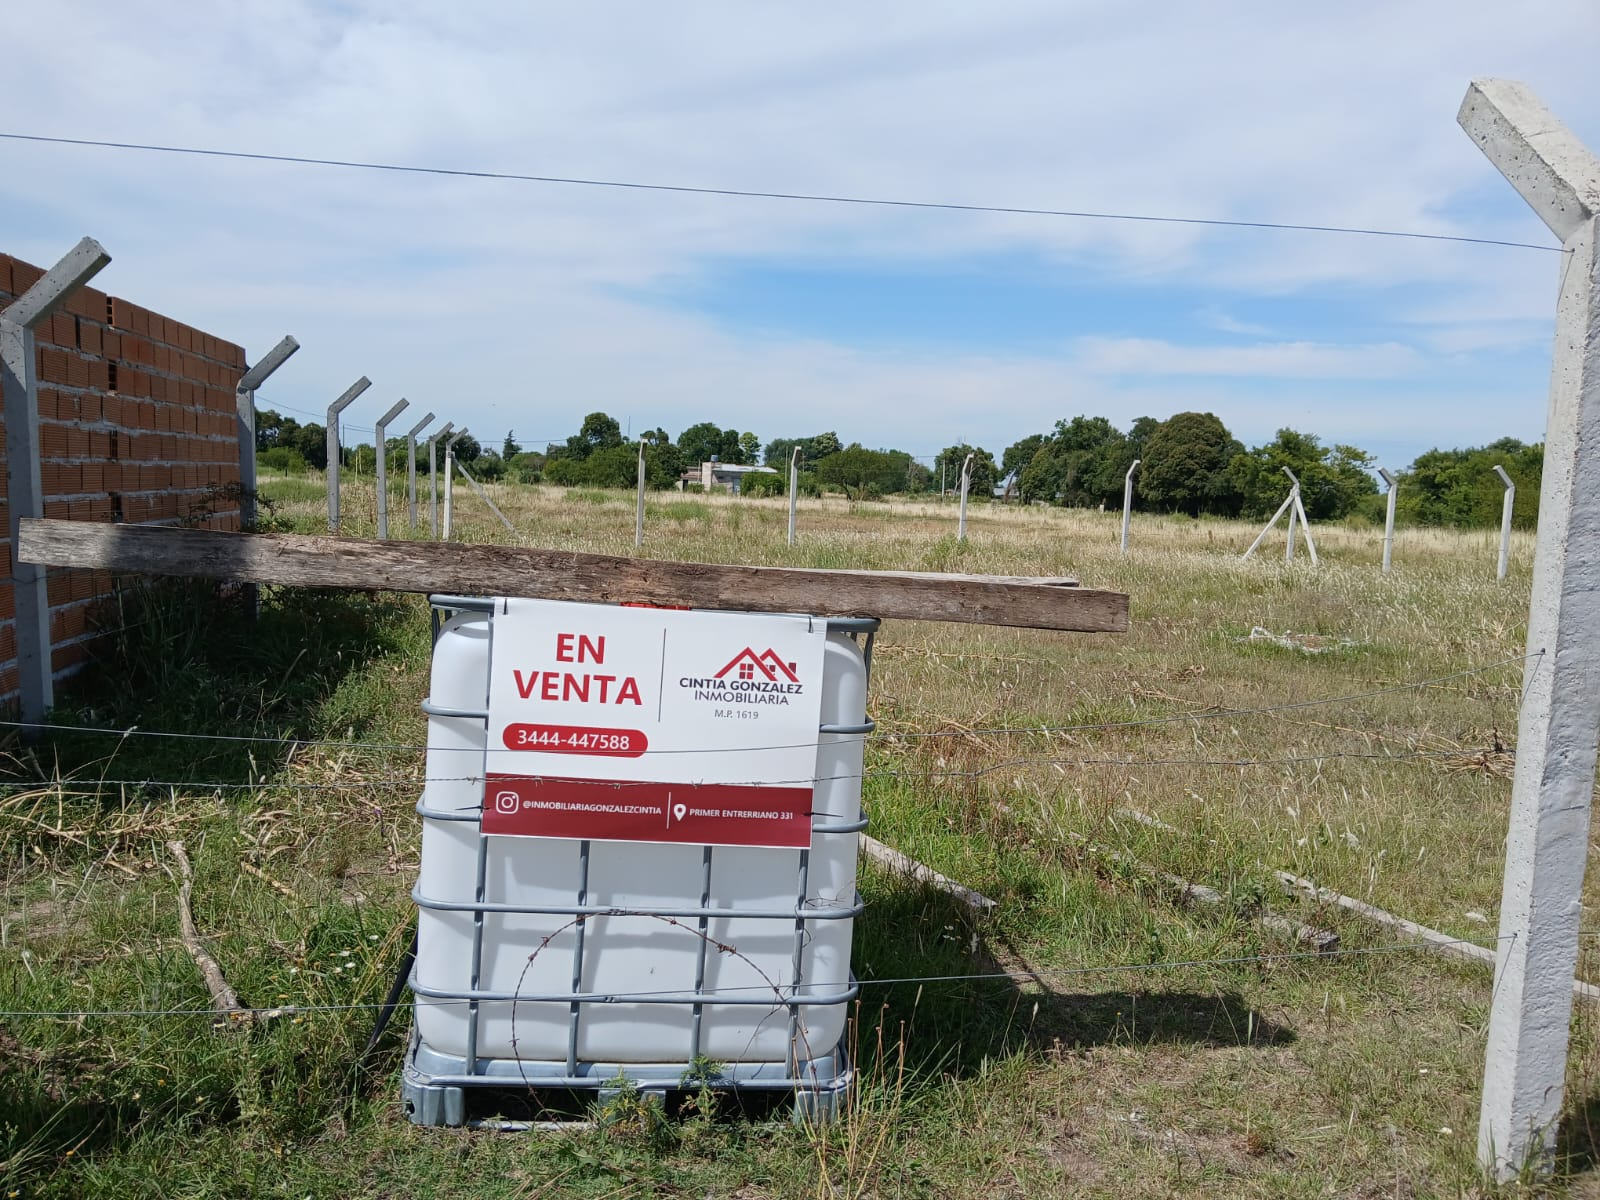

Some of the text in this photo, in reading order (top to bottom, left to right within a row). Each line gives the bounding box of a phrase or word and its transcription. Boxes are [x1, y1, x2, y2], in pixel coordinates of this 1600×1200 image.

[556, 633, 606, 664] EN
[513, 670, 643, 706] VENTA
[679, 677, 803, 695] CINTIA GONZALEZ
[694, 690, 790, 706] INMOBILIARIA
[714, 709, 759, 720] M.P. 1619
[517, 729, 630, 750] 3444-447588
[522, 800, 661, 814] @INMOBILIARIAGONZALEZCINTIA
[689, 808, 793, 820] PRIMER ENTRERRIANO 331
